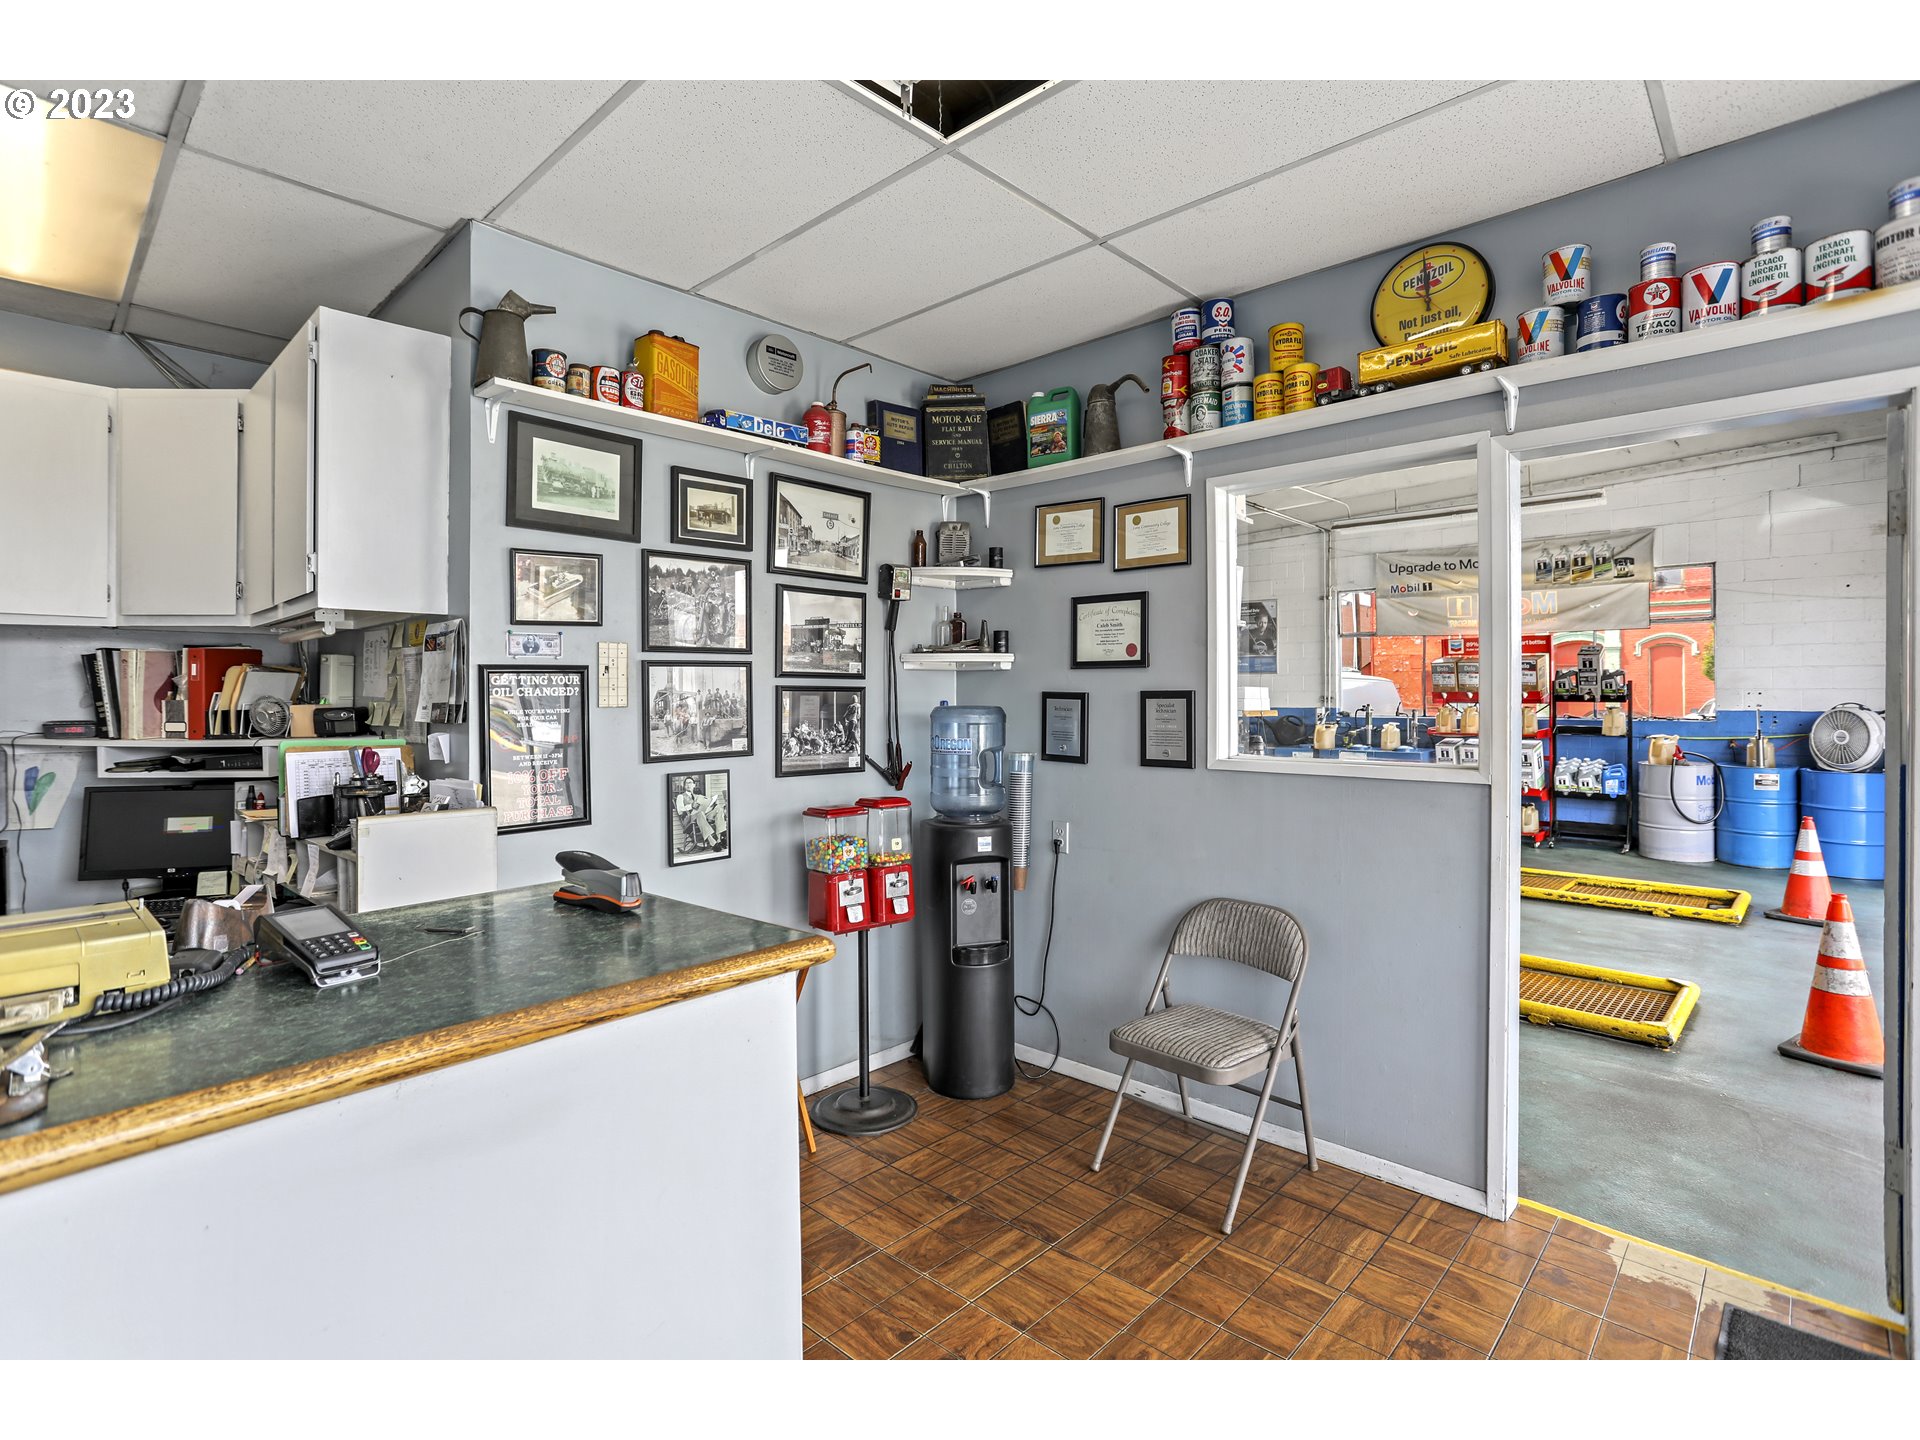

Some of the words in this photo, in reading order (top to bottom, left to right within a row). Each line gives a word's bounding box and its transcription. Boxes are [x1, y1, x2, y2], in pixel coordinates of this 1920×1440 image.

[1819, 238, 1850, 252] TEXACO
[1876, 228, 1915, 250] MOTOR
[1815, 246, 1854, 262] AIRCRAFT
[1754, 256, 1783, 268] TEXACO
[1813, 259, 1841, 271] ENGINE
[1750, 264, 1787, 277] AIRCRAFT
[1547, 277, 1585, 295] VALVOLINE
[1749, 275, 1775, 287] ENGINE
[1215, 307, 1230, 318] S.O.
[1399, 319, 1416, 331] Not
[1421, 311, 1442, 328] just
[1445, 305, 1462, 318] oil,
[1689, 303, 1736, 323] VALVOLINE
[1636, 320, 1676, 333] TEXACO
[1695, 317, 1721, 326] MOTOR
[1638, 330, 1663, 338] MOTOR
[1275, 337, 1292, 346] HYDRA
[1195, 349, 1219, 357] QUAKER
[1386, 341, 1458, 369] PENNZOIL
[1449, 352, 1461, 360] Safe
[1462, 346, 1492, 357] Lubrication
[657, 352, 698, 396] GASOLINE
[932, 415, 962, 424] MOTOR
[964, 415, 982, 423] AGE
[1030, 412, 1057, 426] SIERRA
[754, 418, 785, 438] Delo
[1389, 562, 1441, 575] Upgrade
[1444, 562, 1456, 570] to
[1390, 583, 1420, 594] Mobil
[491, 676, 548, 685] GETTING
[551, 675, 580, 684] YOUR
[492, 687, 514, 697] OIL
[516, 687, 579, 697] CHANGED?
[507, 771, 536, 784] 10%
[539, 768, 568, 782] OFF
[521, 783, 556, 795] YOUR
[517, 795, 561, 808] TOTAL
[504, 805, 573, 822] PURCHASE
